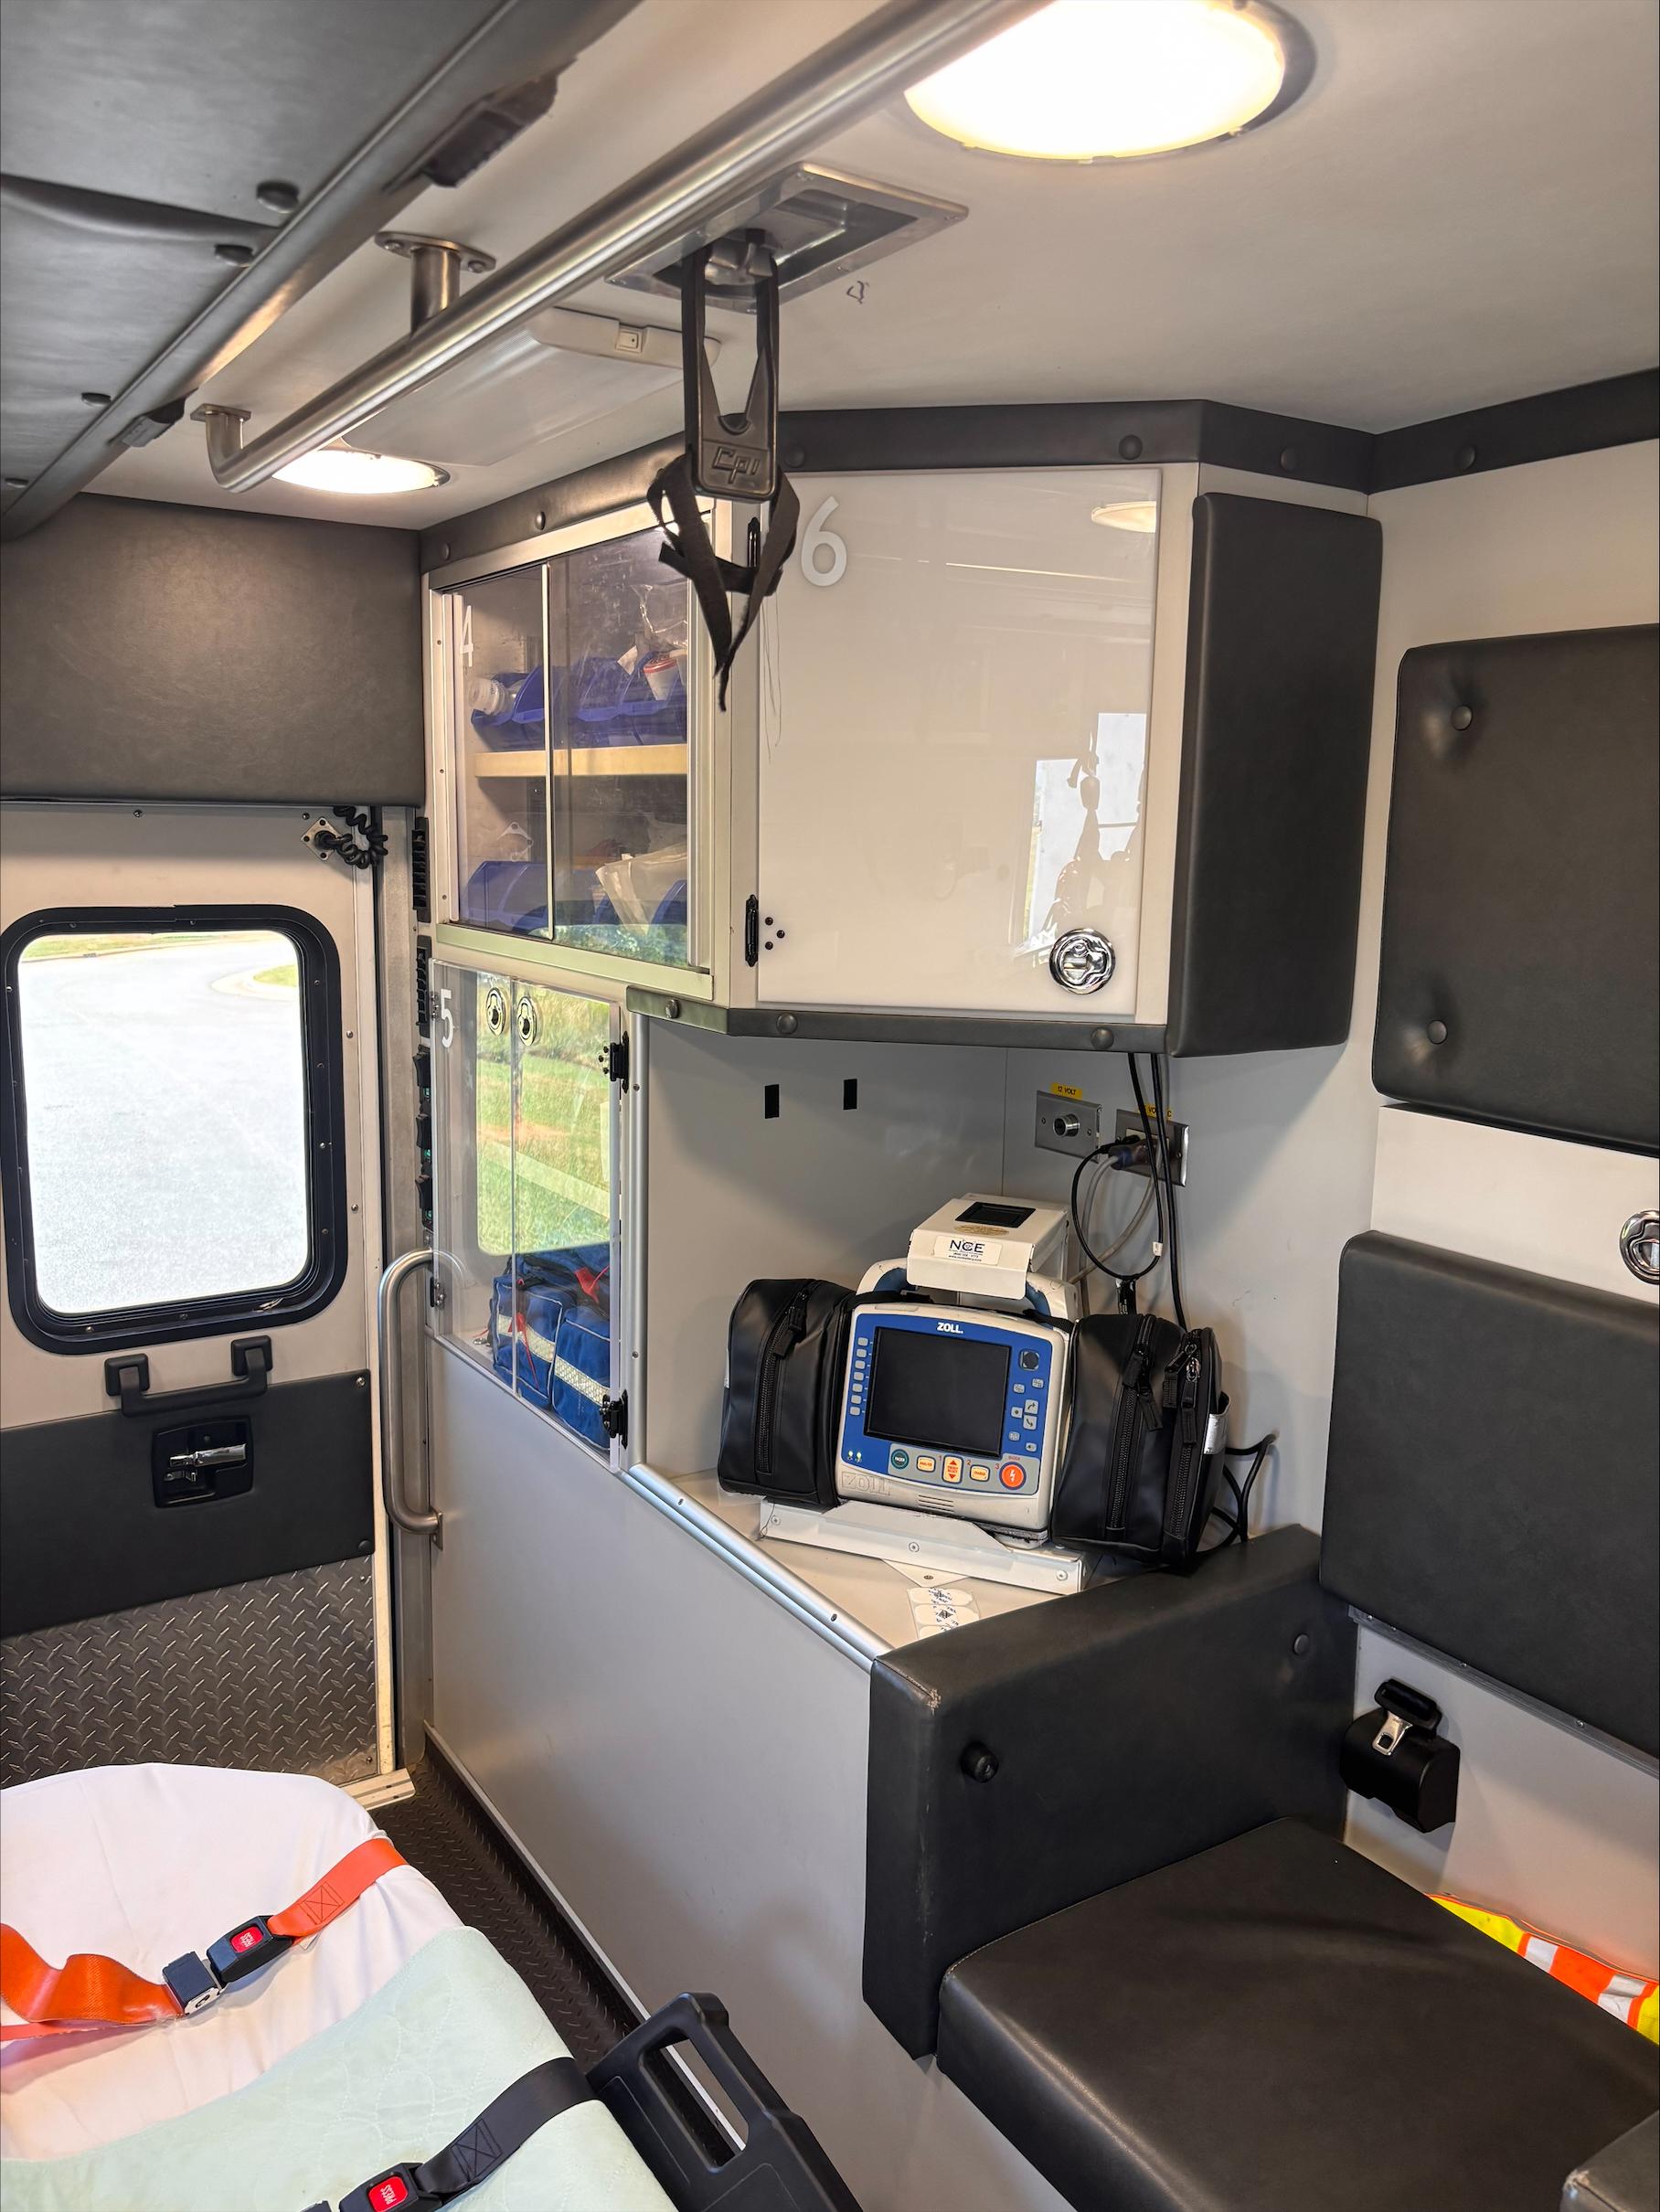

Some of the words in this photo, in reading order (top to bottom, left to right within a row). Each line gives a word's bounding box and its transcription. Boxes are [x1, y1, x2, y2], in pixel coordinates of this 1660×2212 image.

[801, 495, 847, 587] 6
[460, 605, 474, 667] 4
[441, 988, 453, 1048] 5
[1064, 1087, 1077, 1096] VOLT
[950, 1239, 984, 1253] NCE
[380, 2184, 397, 2206] PRESS
